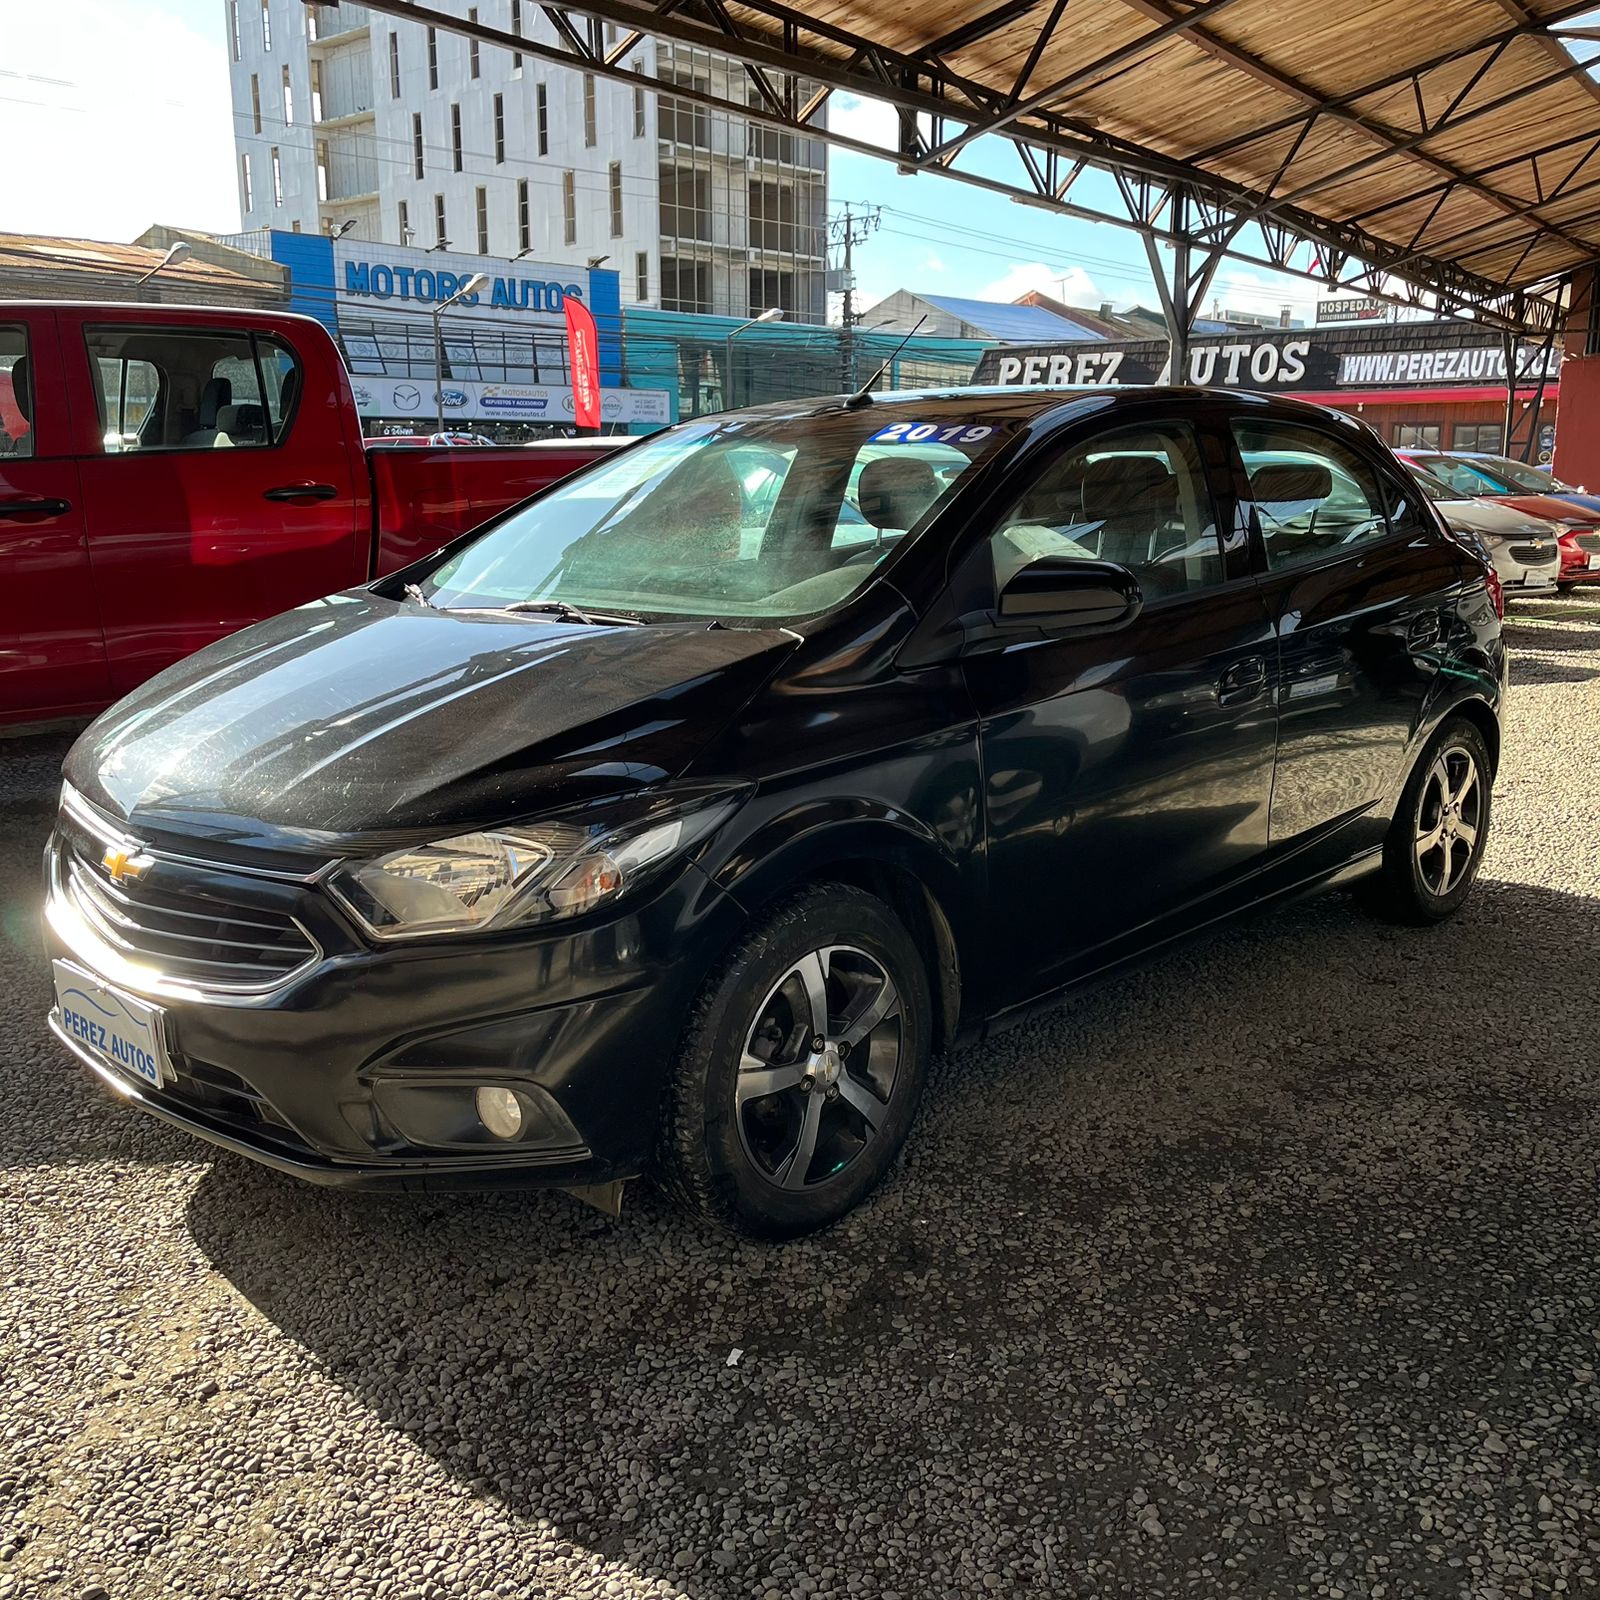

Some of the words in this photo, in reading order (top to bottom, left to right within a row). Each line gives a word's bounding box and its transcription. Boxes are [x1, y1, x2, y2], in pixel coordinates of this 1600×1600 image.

[345, 261, 480, 308] MOTORS
[999, 351, 1125, 386] PEREZ
[442, 391, 463, 406] Ford
[501, 388, 549, 398] MOTORSAUTOS
[875, 423, 993, 443] 2019
[64, 1006, 108, 1051] PEREZ
[111, 1034, 156, 1080] AUTOS
